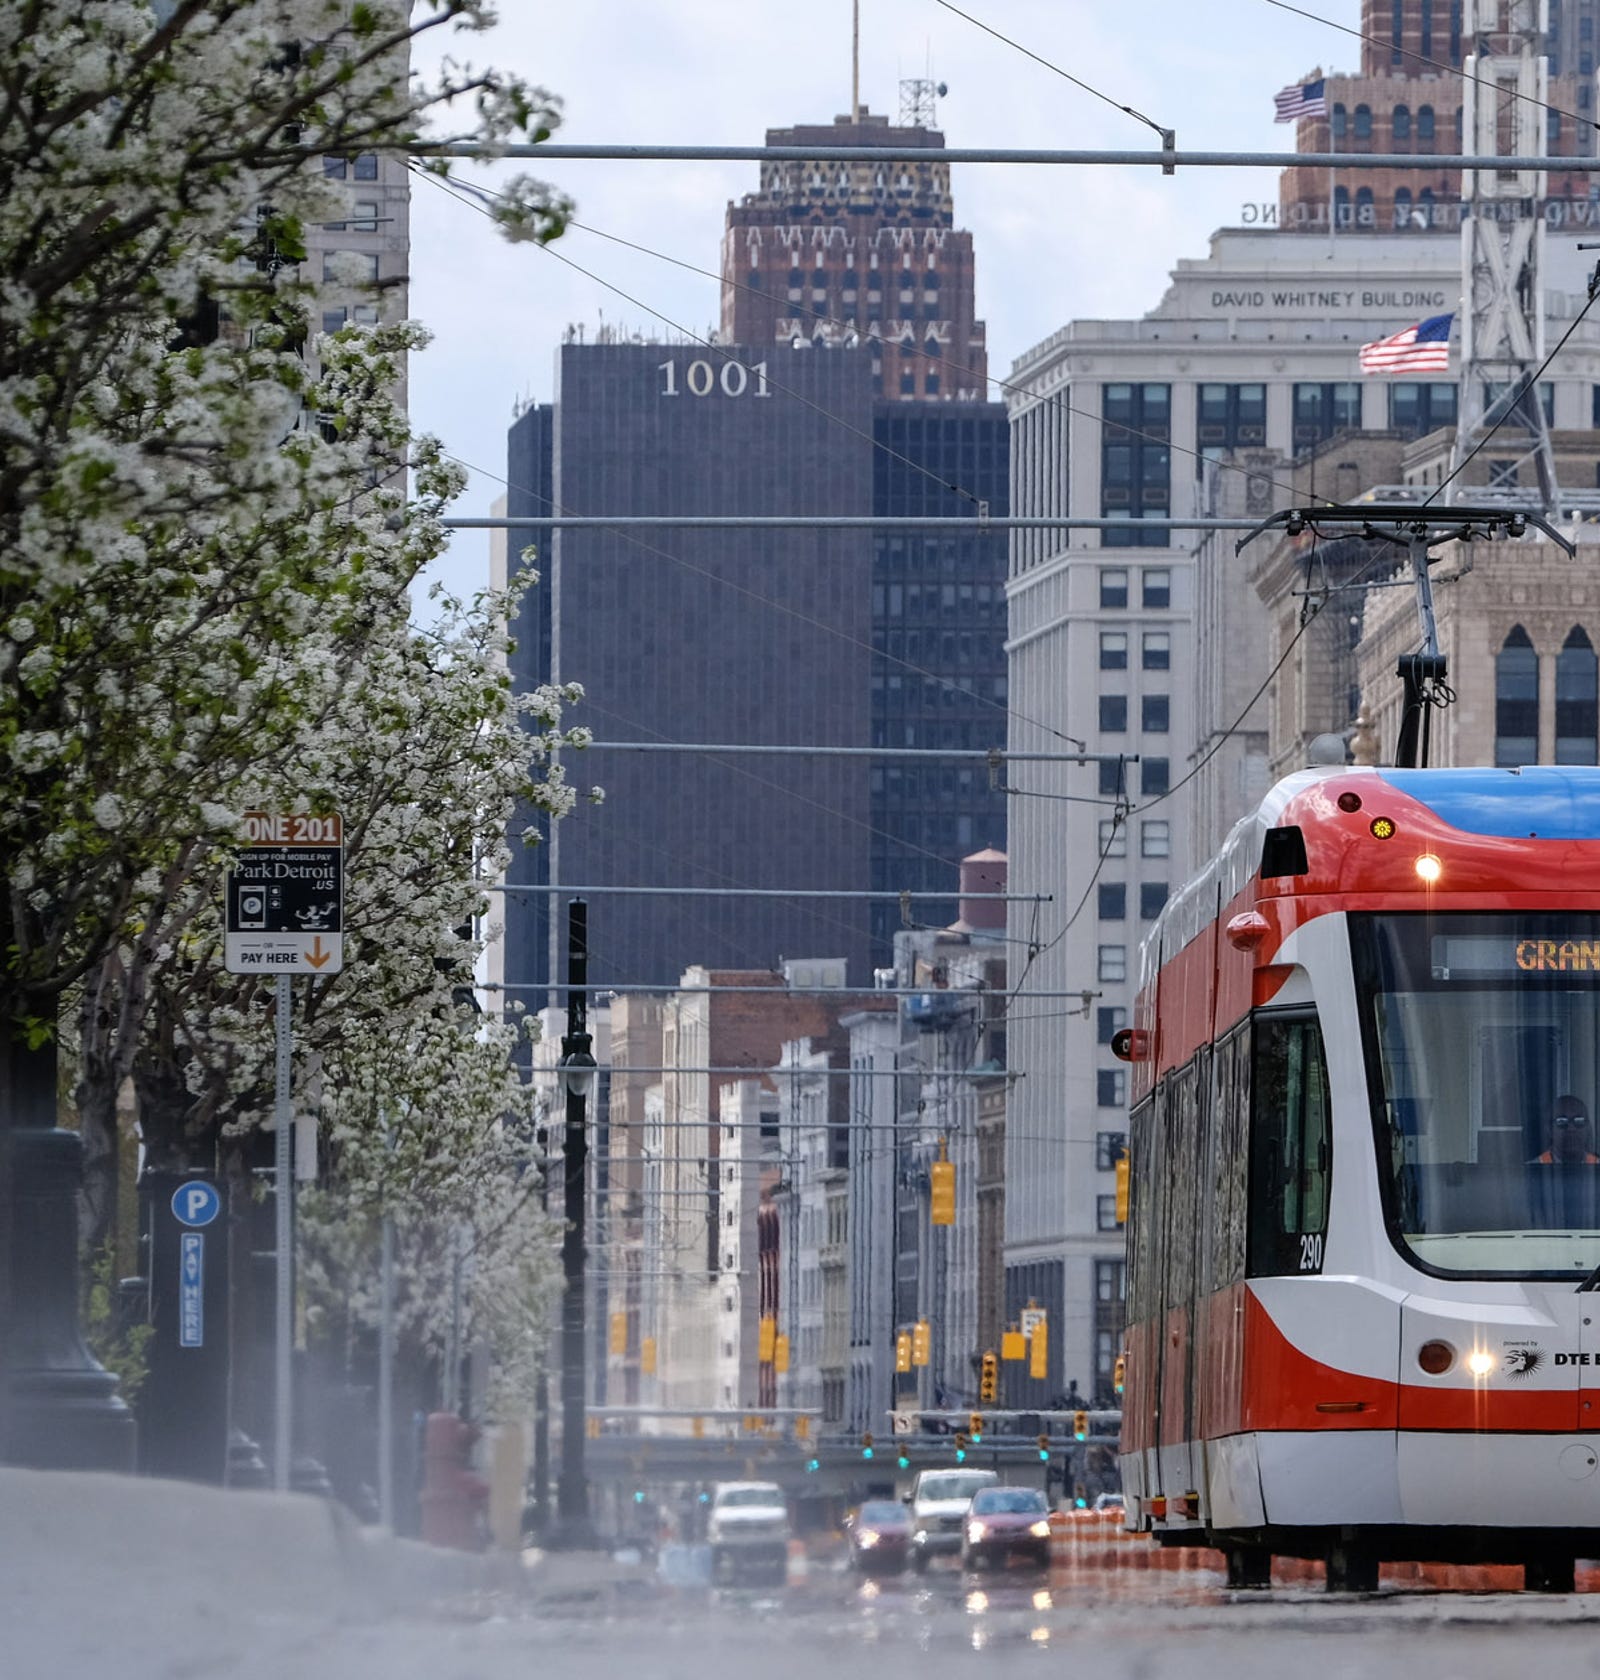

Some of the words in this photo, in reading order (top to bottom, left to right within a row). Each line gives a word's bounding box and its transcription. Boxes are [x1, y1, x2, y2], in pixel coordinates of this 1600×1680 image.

[1212, 292, 1264, 307] DAVID
[1271, 292, 1354, 307] WHITNEY
[1361, 292, 1445, 307] BUILDING
[658, 360, 772, 397] 1001
[242, 817, 290, 842] ONE
[293, 817, 337, 842] 201
[317, 853, 332, 861] PAY
[241, 952, 263, 964] PAY
[266, 952, 298, 964] HERE
[188, 1190, 208, 1219] P
[1300, 1234, 1322, 1269] 290
[1555, 1353, 1590, 1366] DTE
